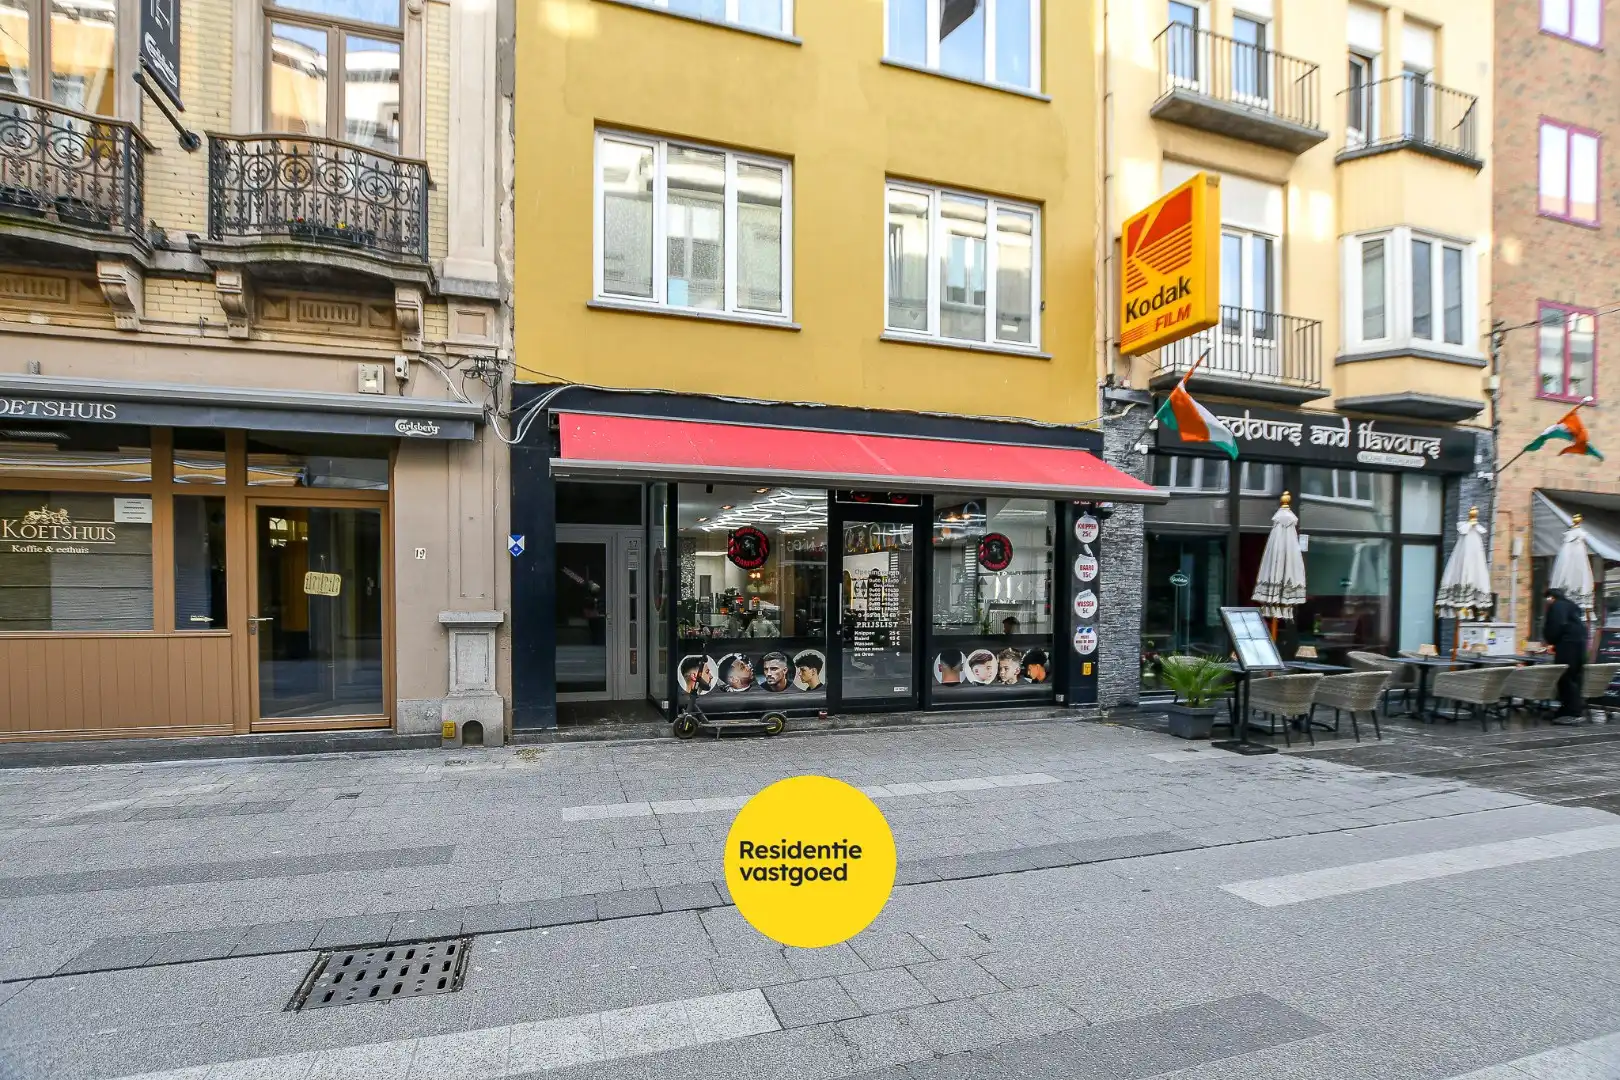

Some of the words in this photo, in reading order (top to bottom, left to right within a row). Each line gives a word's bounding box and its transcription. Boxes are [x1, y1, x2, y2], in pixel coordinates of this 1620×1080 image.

[1126, 275, 1192, 324] Kodak
[1154, 302, 1192, 332] FILM
[395, 418, 441, 437] Carlsberg
[1310, 417, 1352, 448] and
[1357, 420, 1441, 460] flavours
[12, 545, 43, 554] Koffie
[416, 549, 425, 559] 19
